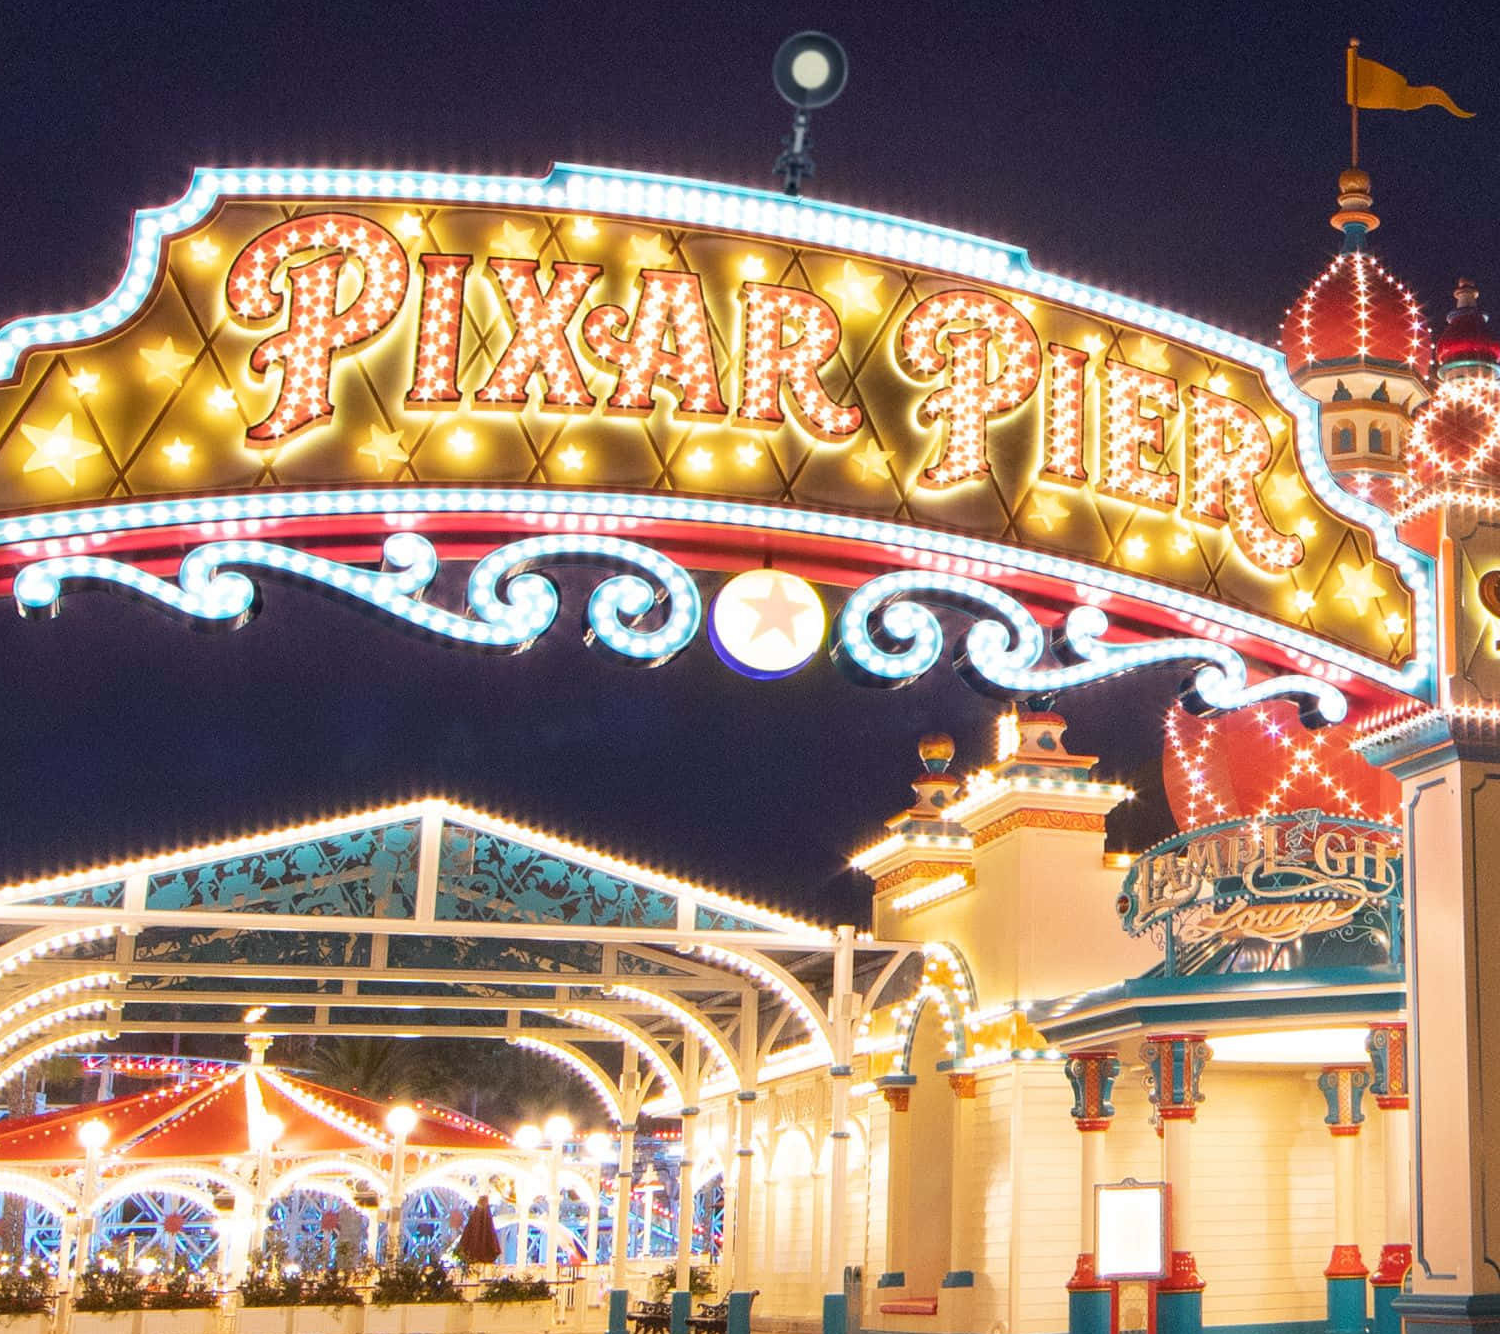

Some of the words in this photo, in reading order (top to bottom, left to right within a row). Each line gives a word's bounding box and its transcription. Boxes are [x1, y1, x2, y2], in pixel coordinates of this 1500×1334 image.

[226, 211, 863, 450] PIXAR
[900, 288, 1305, 569] PIER
[1133, 808, 1401, 925] LAMPLIGH
[1184, 893, 1368, 942] Lounge
